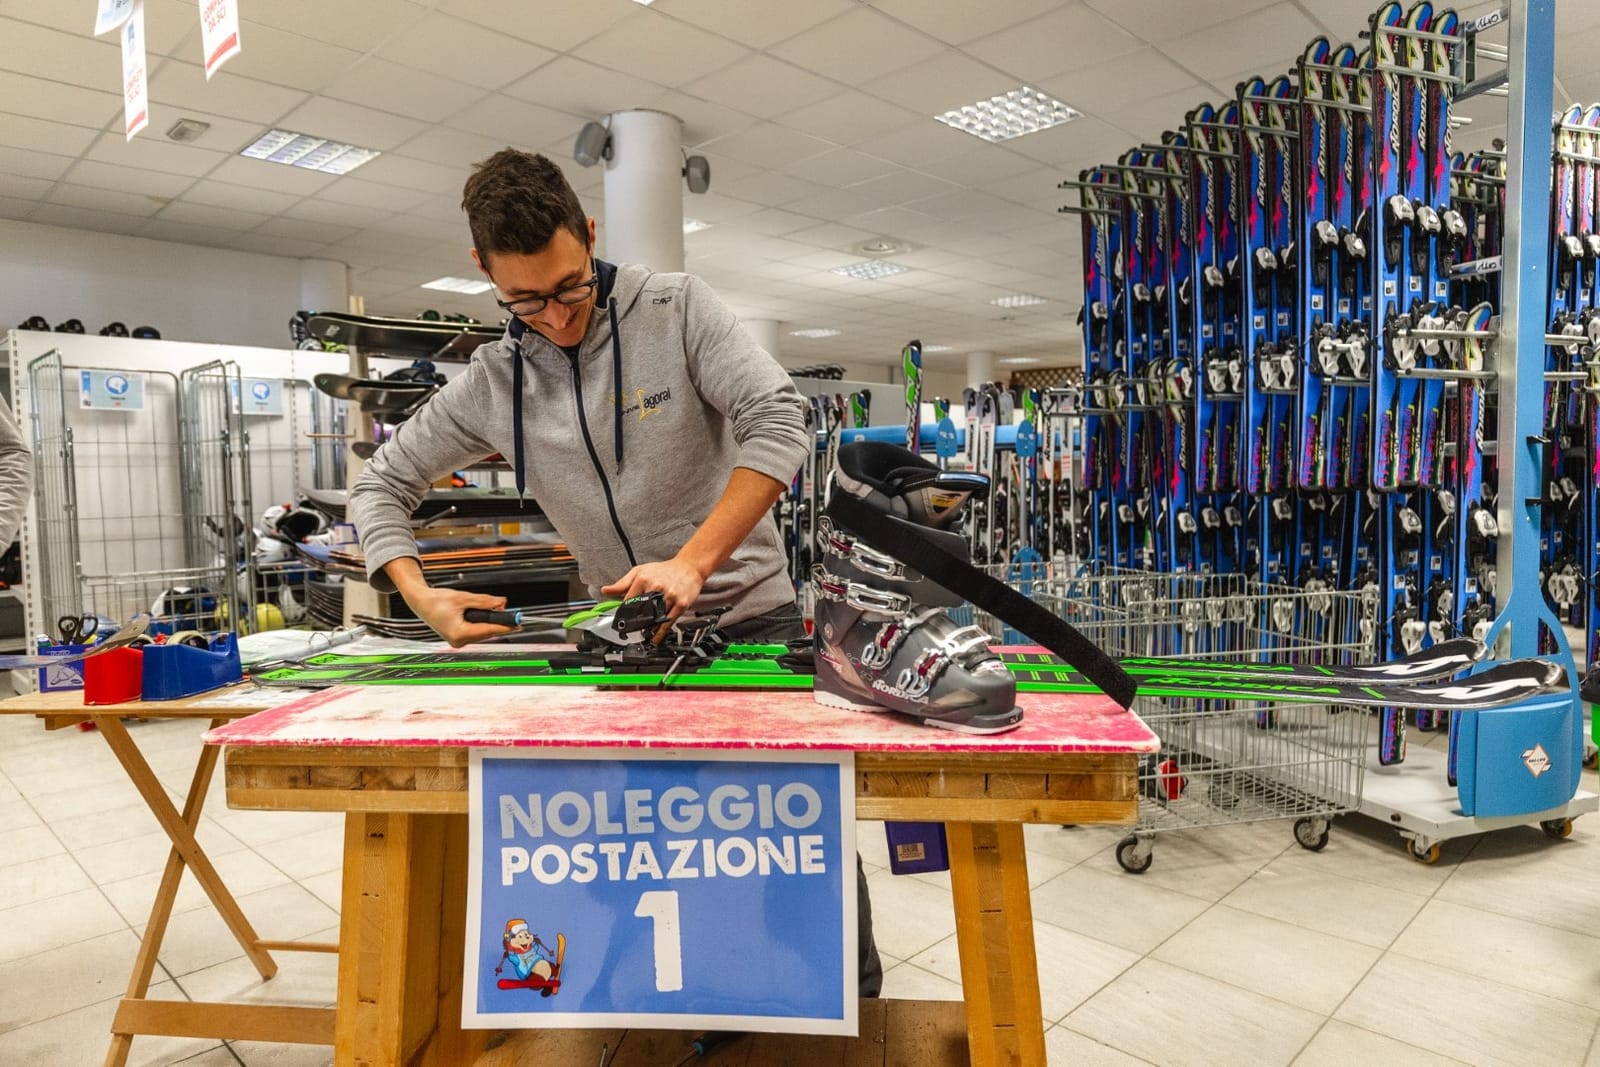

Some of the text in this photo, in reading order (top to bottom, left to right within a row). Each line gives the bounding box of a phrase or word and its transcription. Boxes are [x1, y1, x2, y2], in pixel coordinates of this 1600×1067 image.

[1317, 104, 1326, 178] NORDICA
[1344, 109, 1353, 183] NORDICA
[1418, 78, 1427, 152] NORDIC
[1444, 79, 1453, 157] NORDIC
[1475, 377, 1485, 451] NORDIC
[1119, 657, 1295, 672] NORDICA
[1144, 677, 1341, 695] NORDICA
[499, 782, 822, 839] NOLEGGIO
[501, 835, 826, 886] POSTAZIONE
[634, 890, 683, 992] 1
